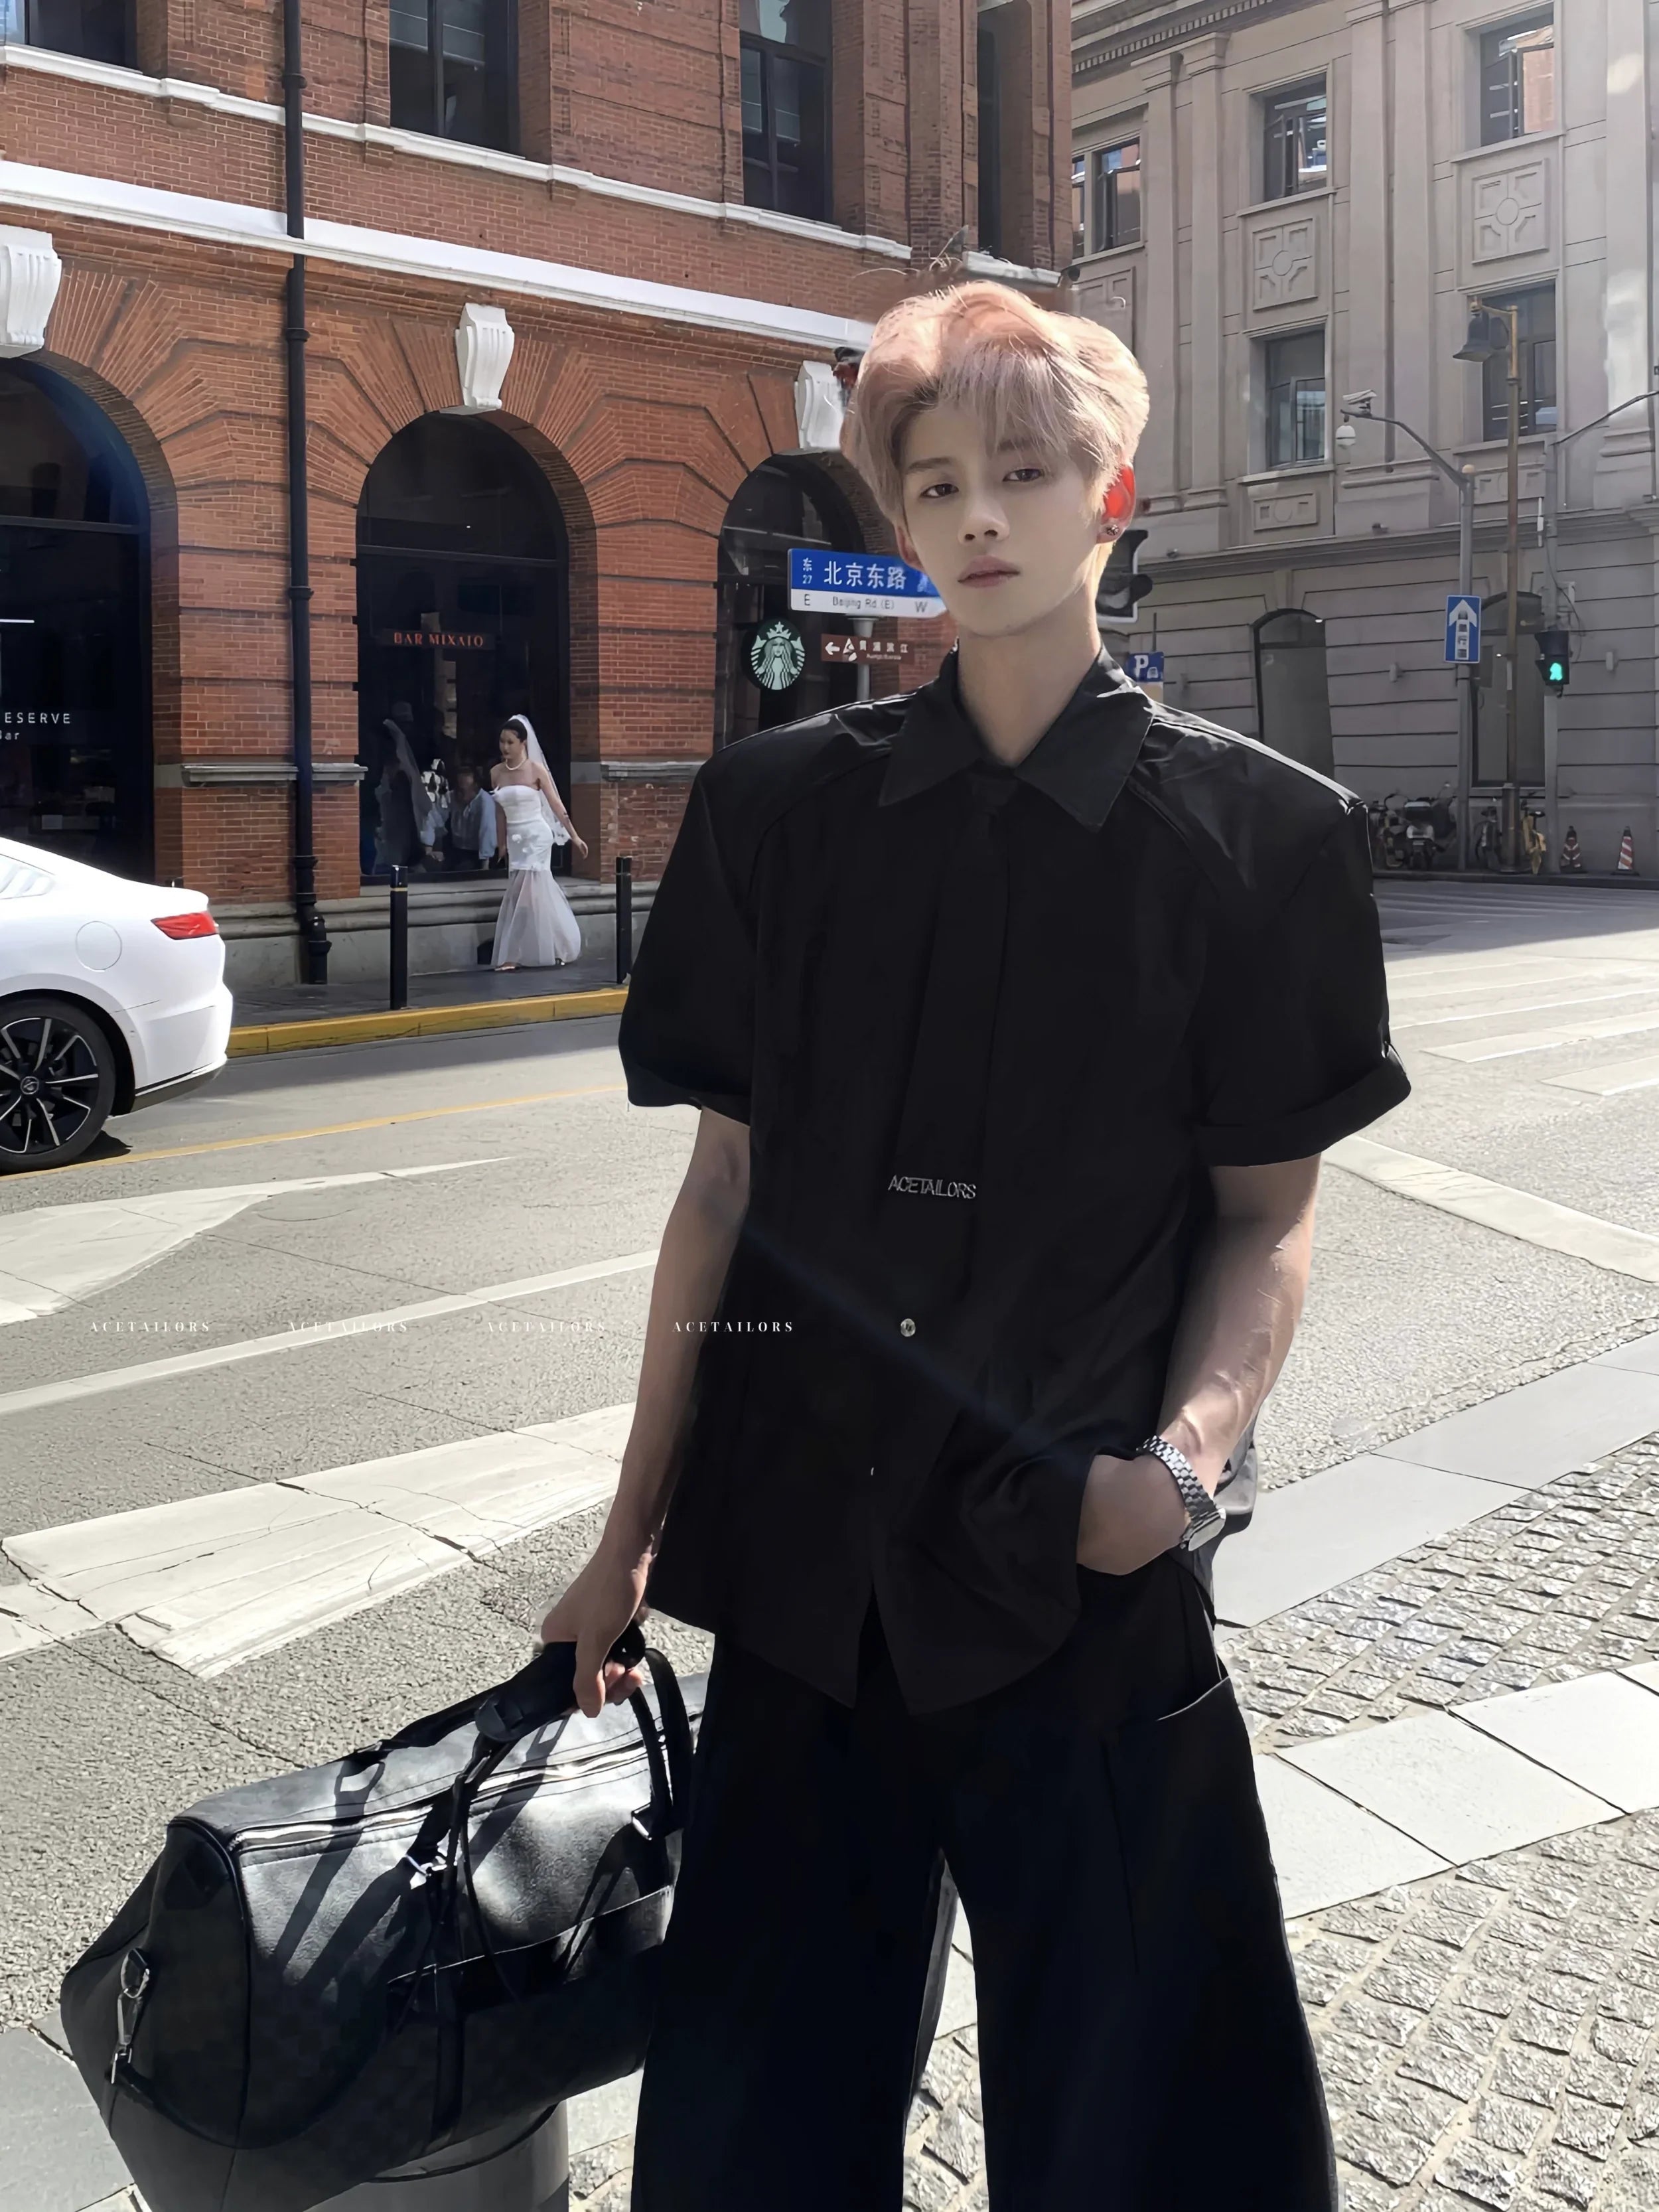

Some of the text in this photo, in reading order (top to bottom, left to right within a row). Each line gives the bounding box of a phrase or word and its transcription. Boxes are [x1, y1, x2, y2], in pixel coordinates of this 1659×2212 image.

[824, 560, 906, 590] 北京东路
[804, 593, 811, 606] E
[865, 598, 877, 609] Rd
[881, 599, 895, 610] (E)
[915, 601, 928, 613] W
[1134, 654, 1149, 678] P
[0, 730, 20, 740] ar
[888, 1174, 977, 1199] ACETAILORS
